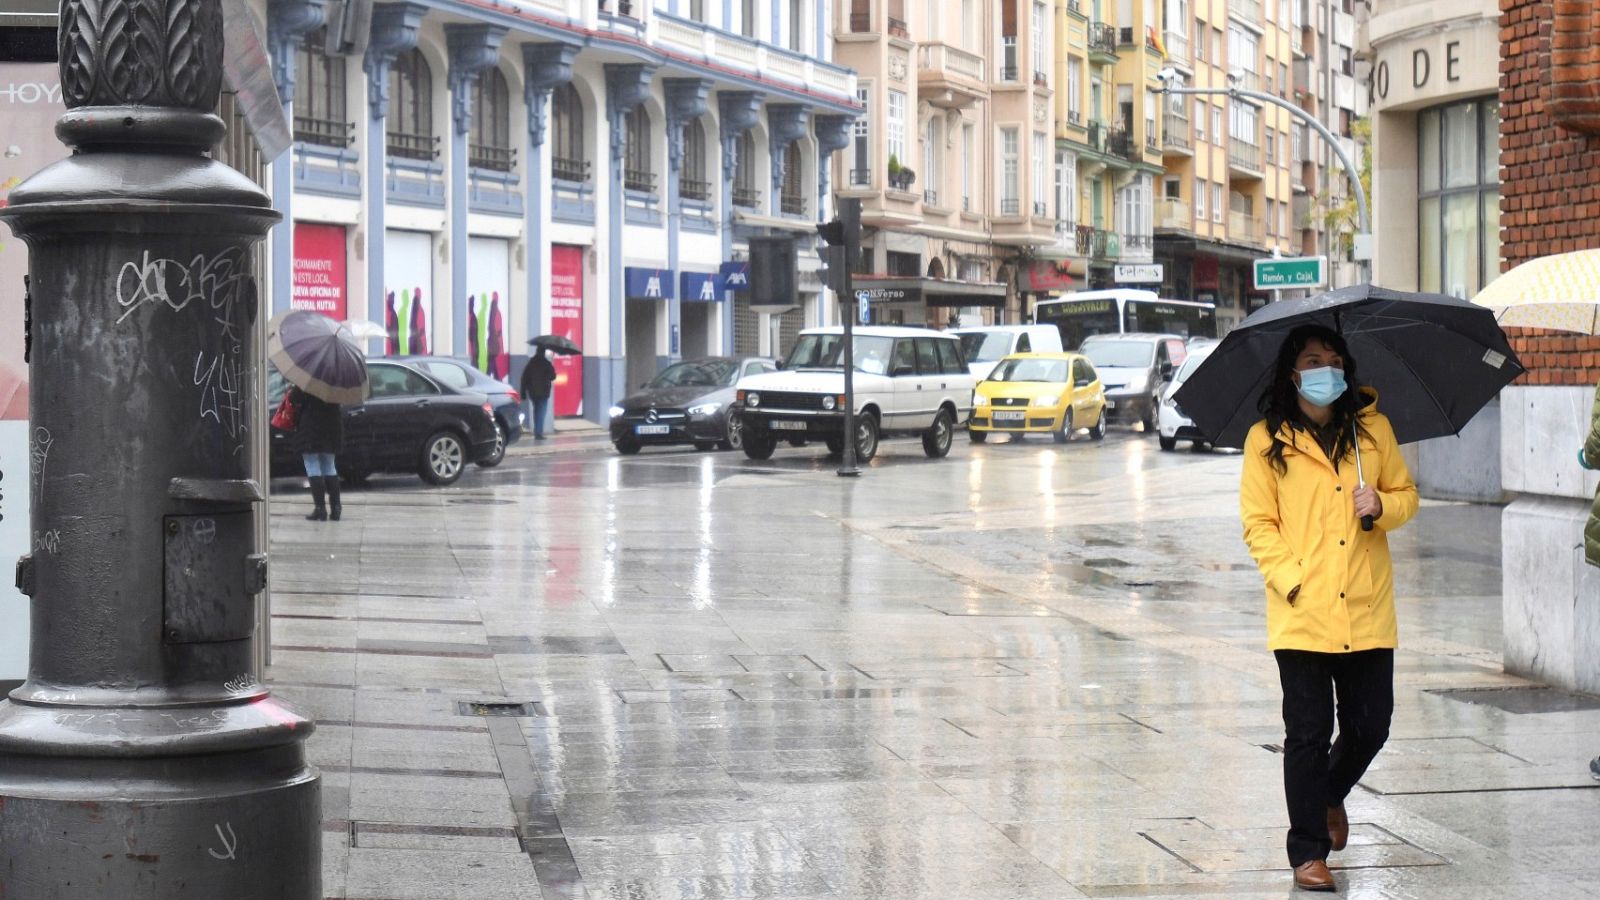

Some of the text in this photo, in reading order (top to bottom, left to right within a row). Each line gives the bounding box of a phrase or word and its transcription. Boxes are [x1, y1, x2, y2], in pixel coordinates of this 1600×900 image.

[1412, 41, 1460, 88] DE
[726, 272, 747, 285] AXA
[1262, 272, 1285, 283] Ramón
[1296, 271, 1314, 282] Cajal
[644, 276, 662, 297] AXA
[700, 280, 715, 300] AXA
[316, 300, 336, 311] KUTXA
